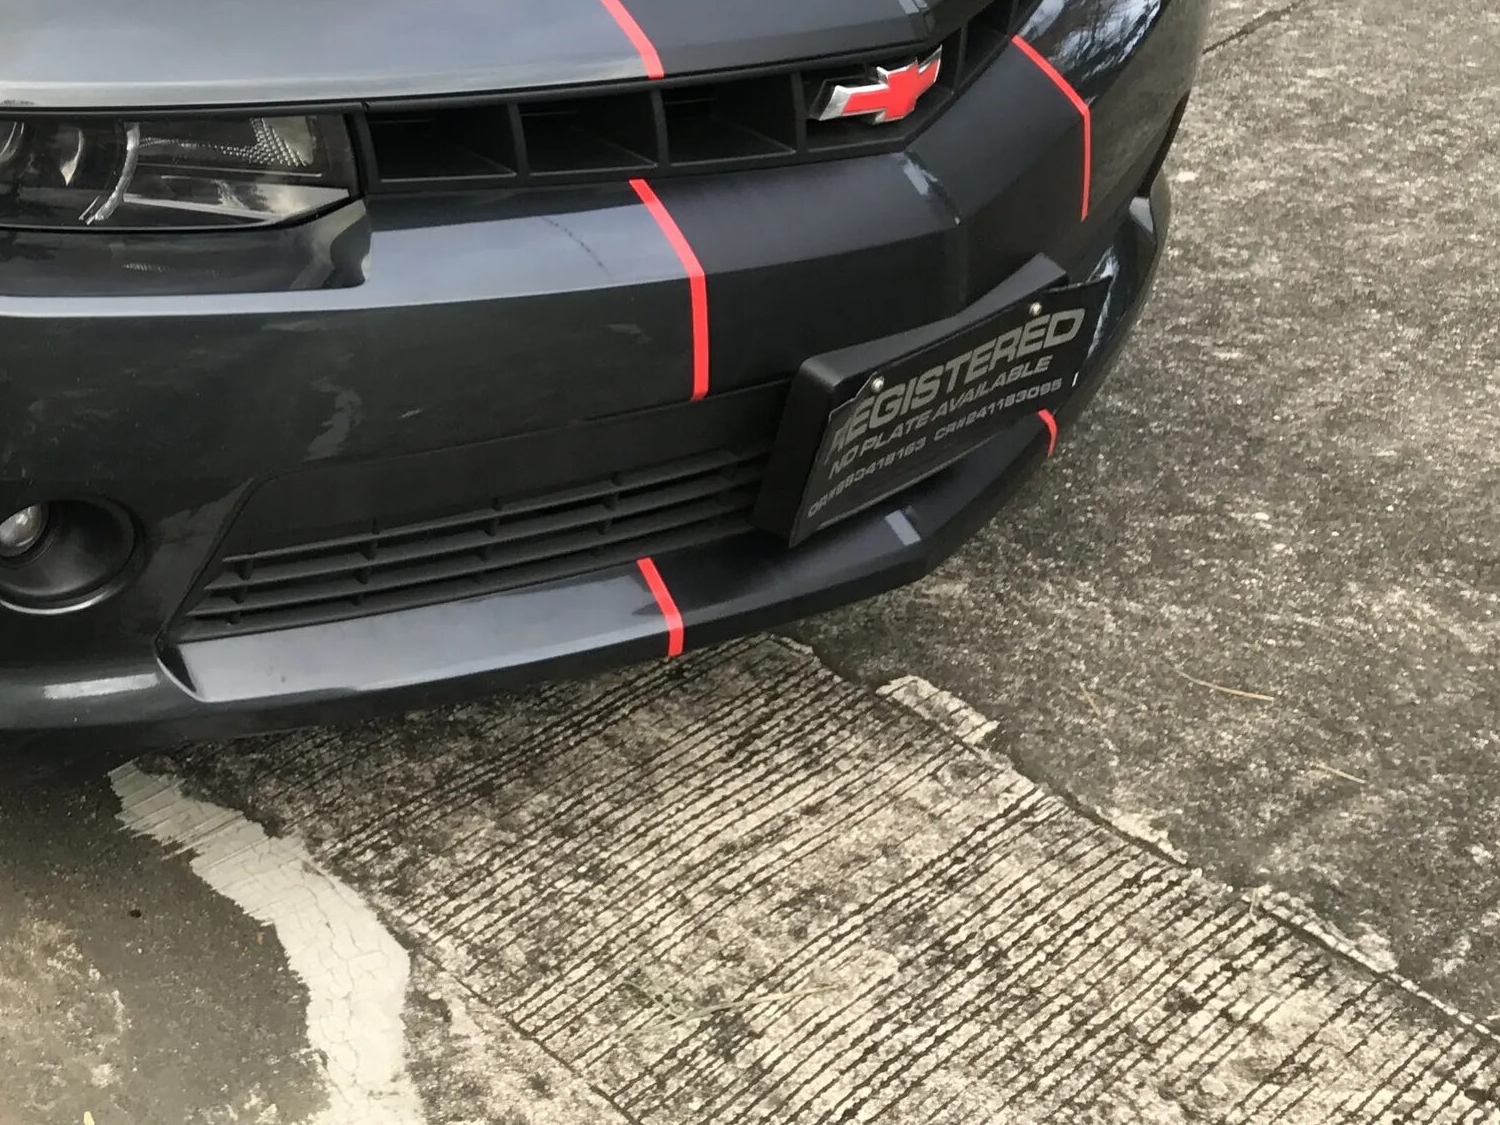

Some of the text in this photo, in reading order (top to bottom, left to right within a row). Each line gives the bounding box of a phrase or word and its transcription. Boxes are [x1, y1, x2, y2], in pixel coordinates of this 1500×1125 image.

[828, 354, 1053, 480] NO PLATE AVAILABLE
